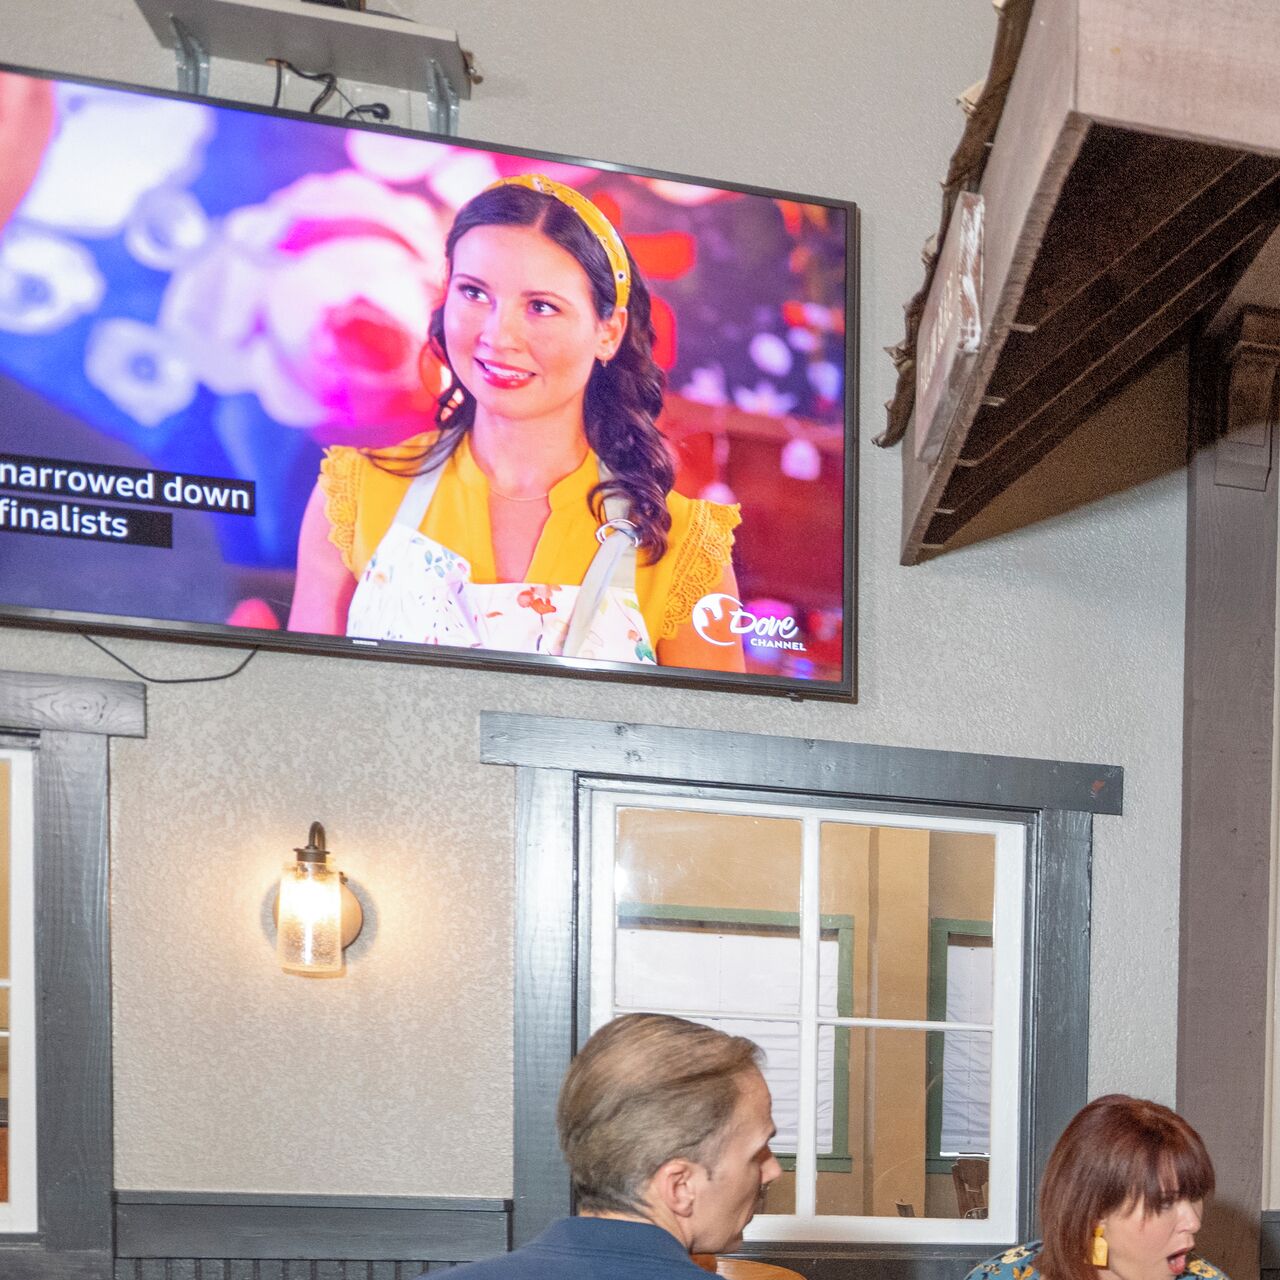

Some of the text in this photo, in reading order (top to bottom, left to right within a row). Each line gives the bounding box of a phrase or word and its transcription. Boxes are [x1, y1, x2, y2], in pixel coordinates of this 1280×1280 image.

[0, 463, 250, 510] narrowed down
[0, 498, 128, 538] finalists
[729, 608, 799, 639] Dove
[750, 637, 807, 652] CHANNEL
